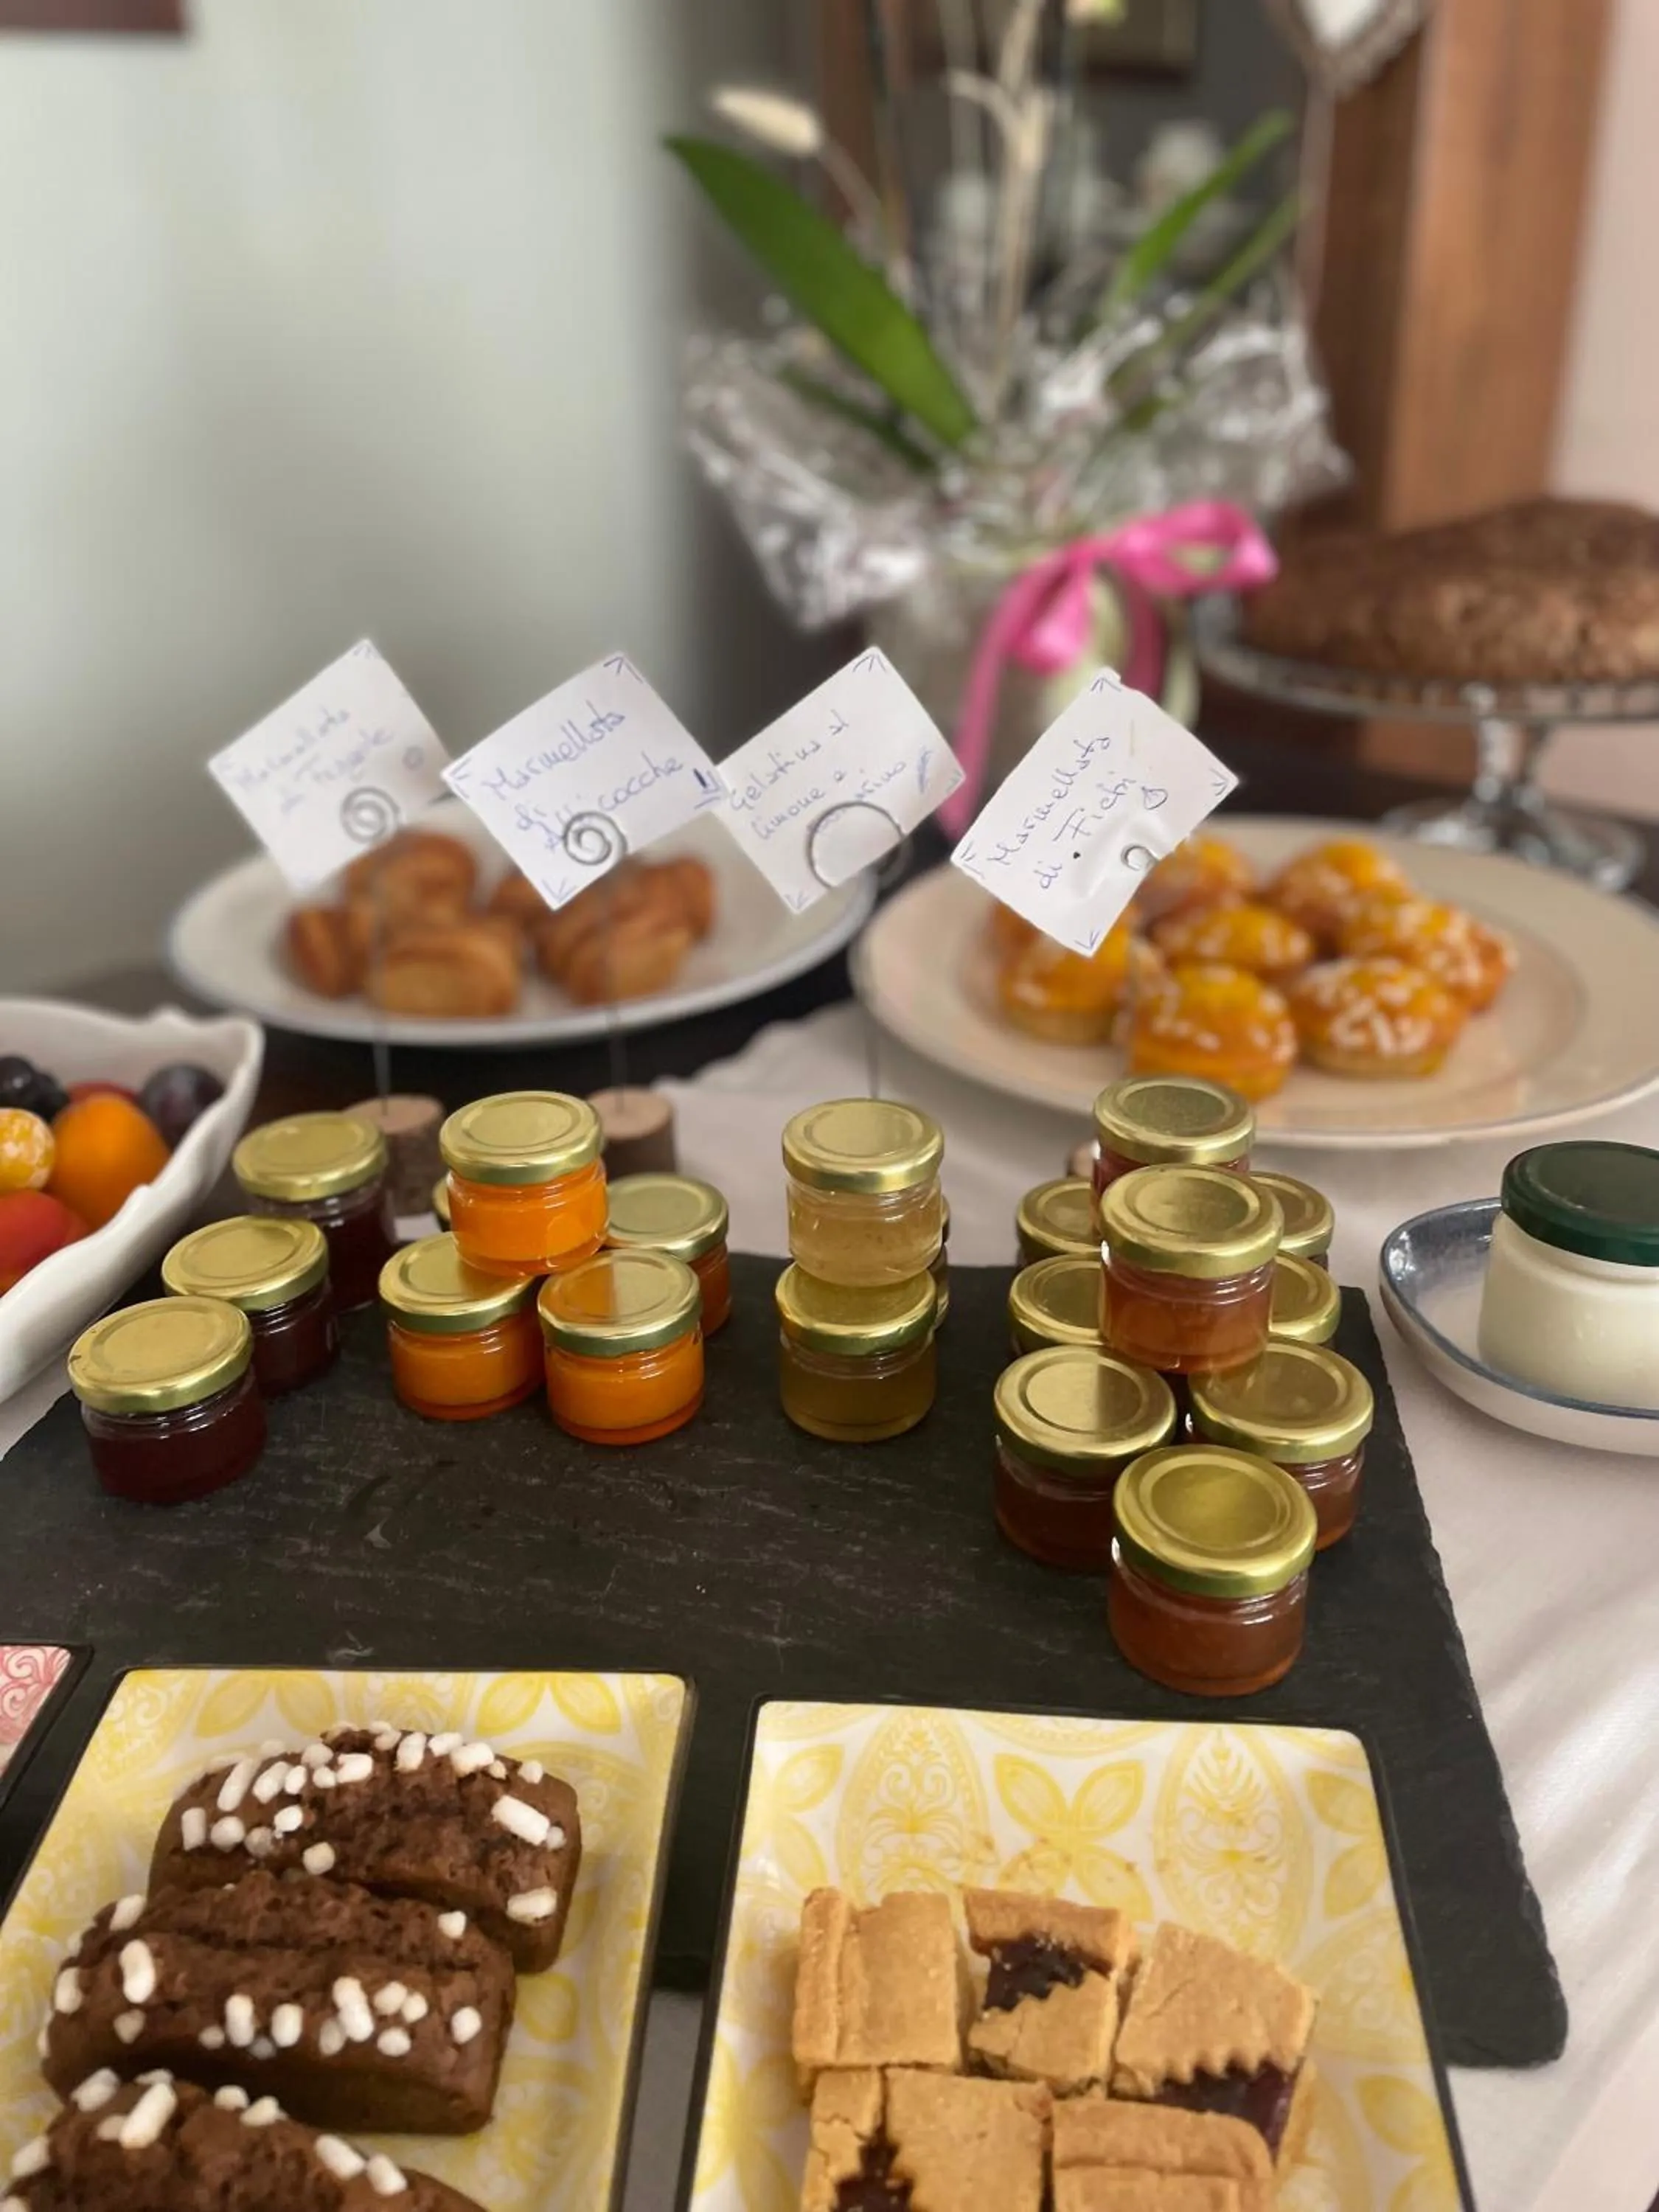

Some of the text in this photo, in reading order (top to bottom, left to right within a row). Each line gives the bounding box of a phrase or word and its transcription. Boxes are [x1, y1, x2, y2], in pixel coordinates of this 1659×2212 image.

[481, 699, 626, 801] Marmellata
[987, 737, 1111, 865] Marmellata
[1033, 771, 1136, 890] di Fichi
